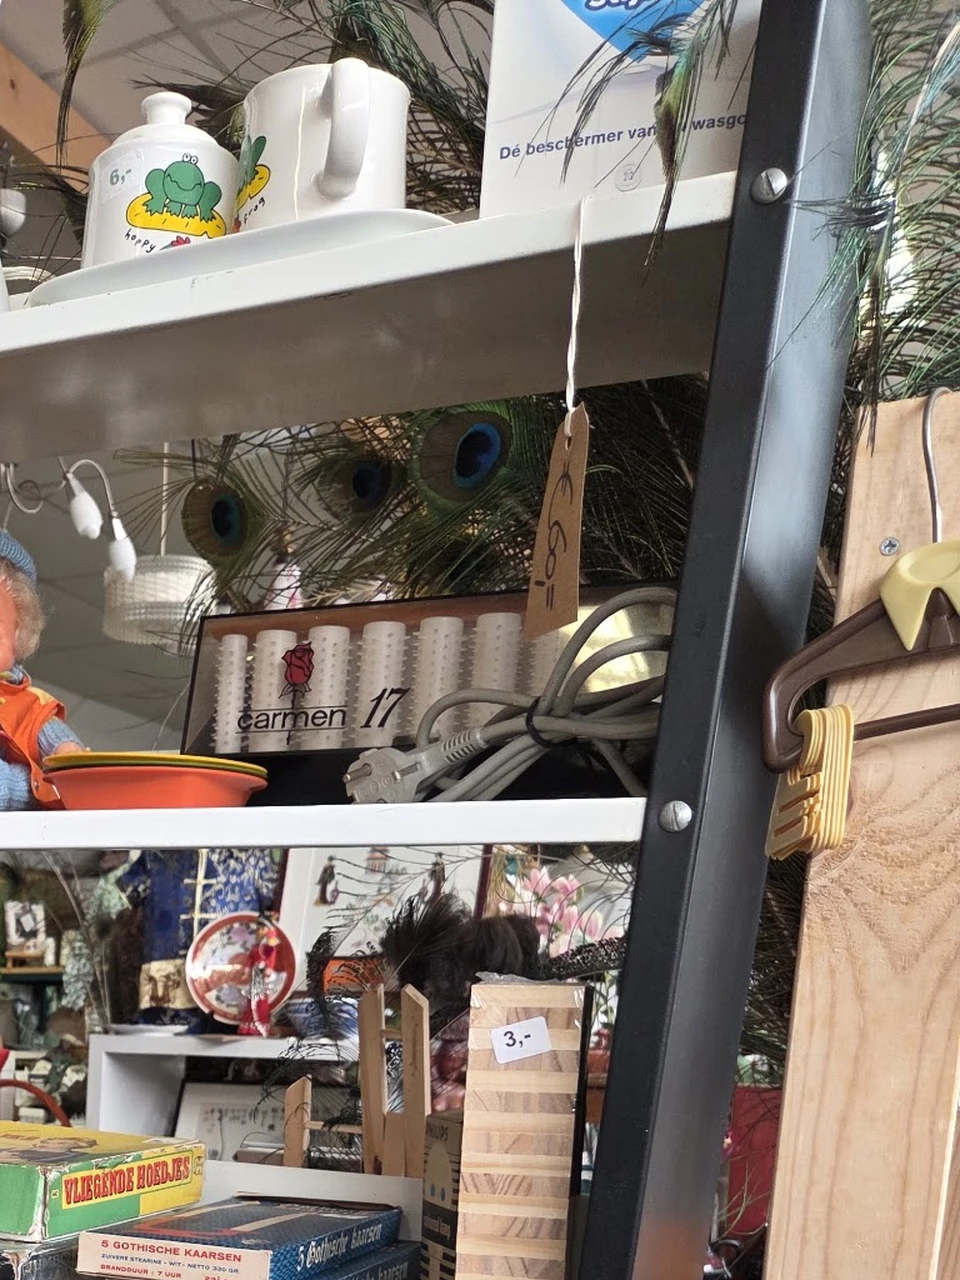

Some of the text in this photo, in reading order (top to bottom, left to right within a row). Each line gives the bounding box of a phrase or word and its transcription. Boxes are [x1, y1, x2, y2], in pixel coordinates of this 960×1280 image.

[499, 123, 657, 160] Dé beschermer van
[109, 168, 132, 186] 6,-
[236, 687, 411, 731] carmen 17
[503, 1030, 532, 1050] 3,-
[63, 1154, 191, 1205] VLIEGENDE HOEDJES
[100, 1239, 242, 1263] 5 GOTHISCHE KAARSEN
[100, 1253, 129, 1262] ZUIVERE
[130, 1256, 162, 1266] STEARINE
[187, 1262, 211, 1271] NETTO
[297, 1245, 305, 1272] 5
[305, 1232, 348, 1269] Gothische
[100, 1264, 149, 1276] BRANDDUUR
[164, 1271, 182, 1279] UUR
